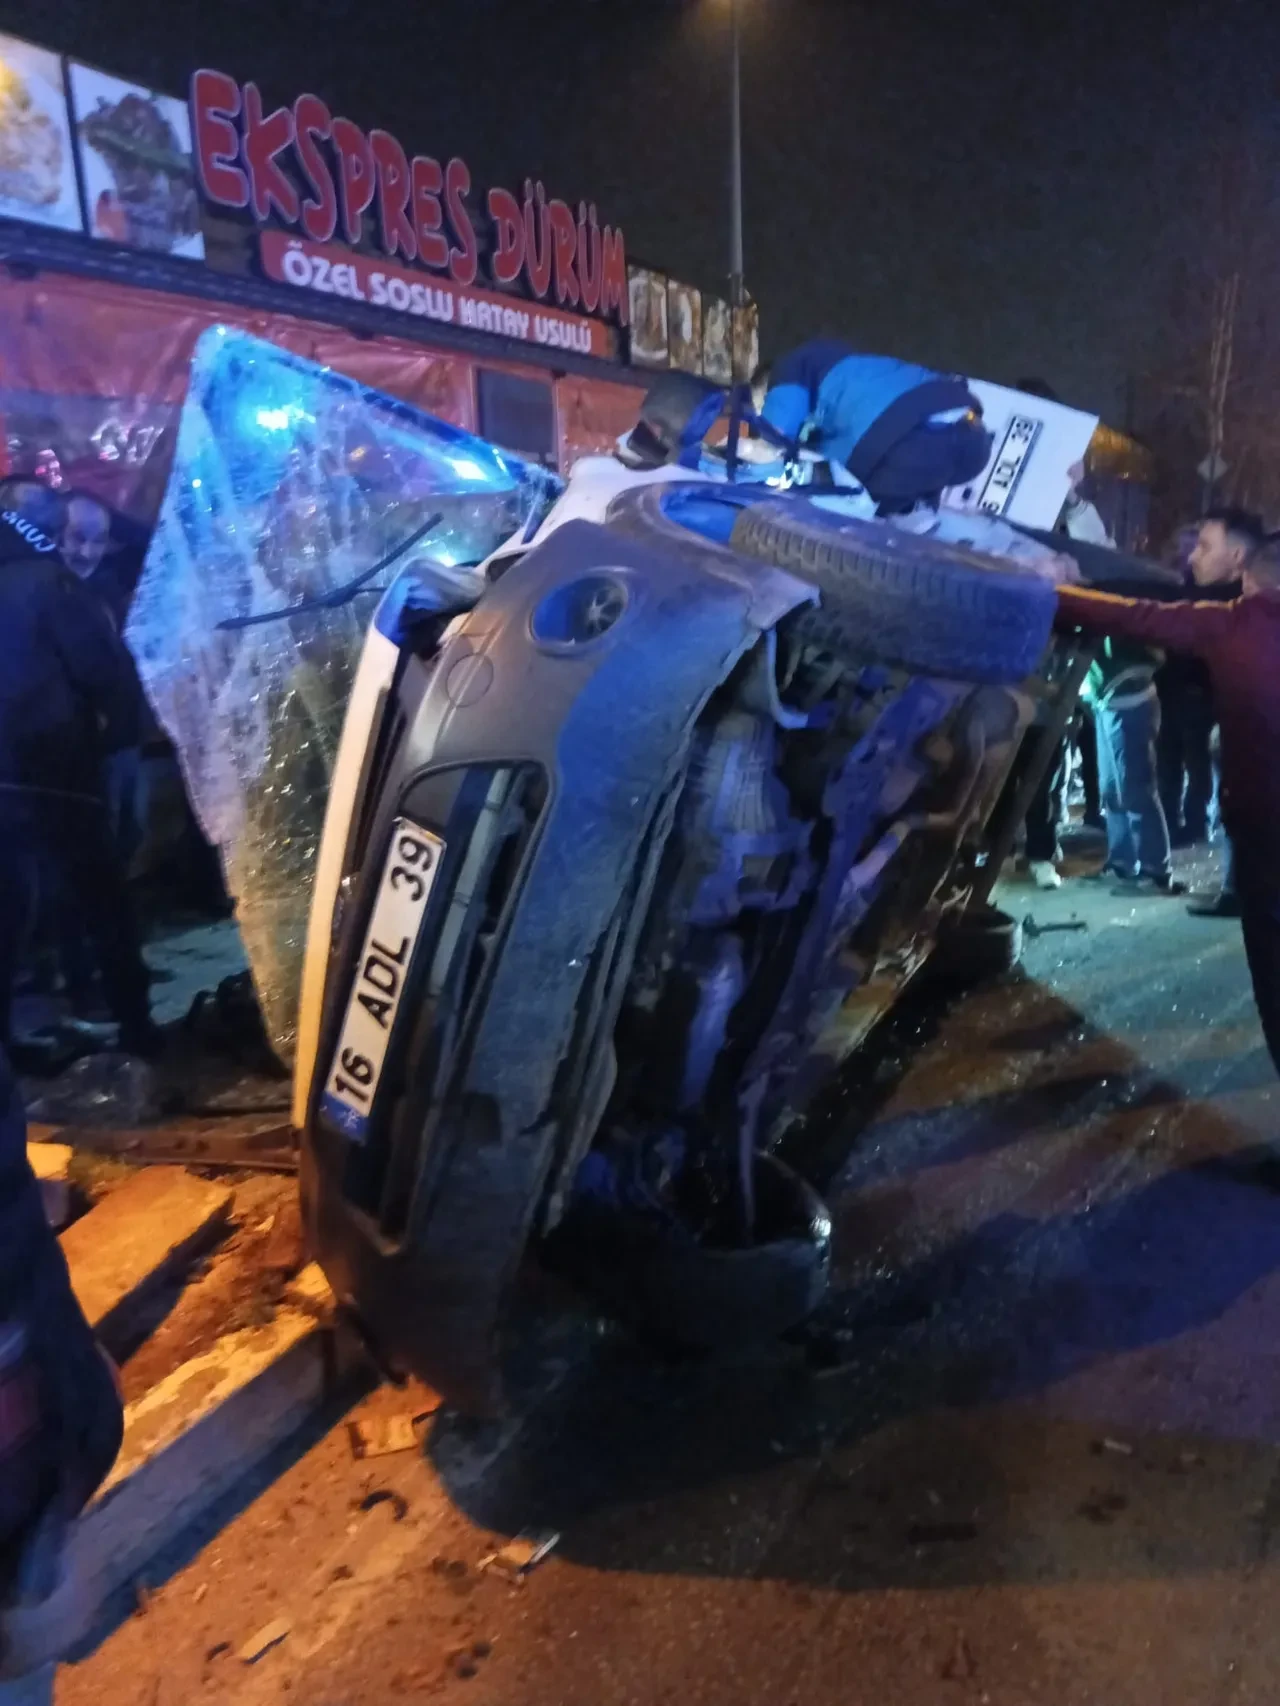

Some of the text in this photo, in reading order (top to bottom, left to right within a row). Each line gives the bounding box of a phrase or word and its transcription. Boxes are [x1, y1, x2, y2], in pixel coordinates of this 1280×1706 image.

[190, 68, 630, 327] EKSPRES DÜRÜM
[281, 240, 593, 353] ÖZEL SOSLU HATAY USULÜ
[333, 834, 435, 1104] 16 ADL 39
